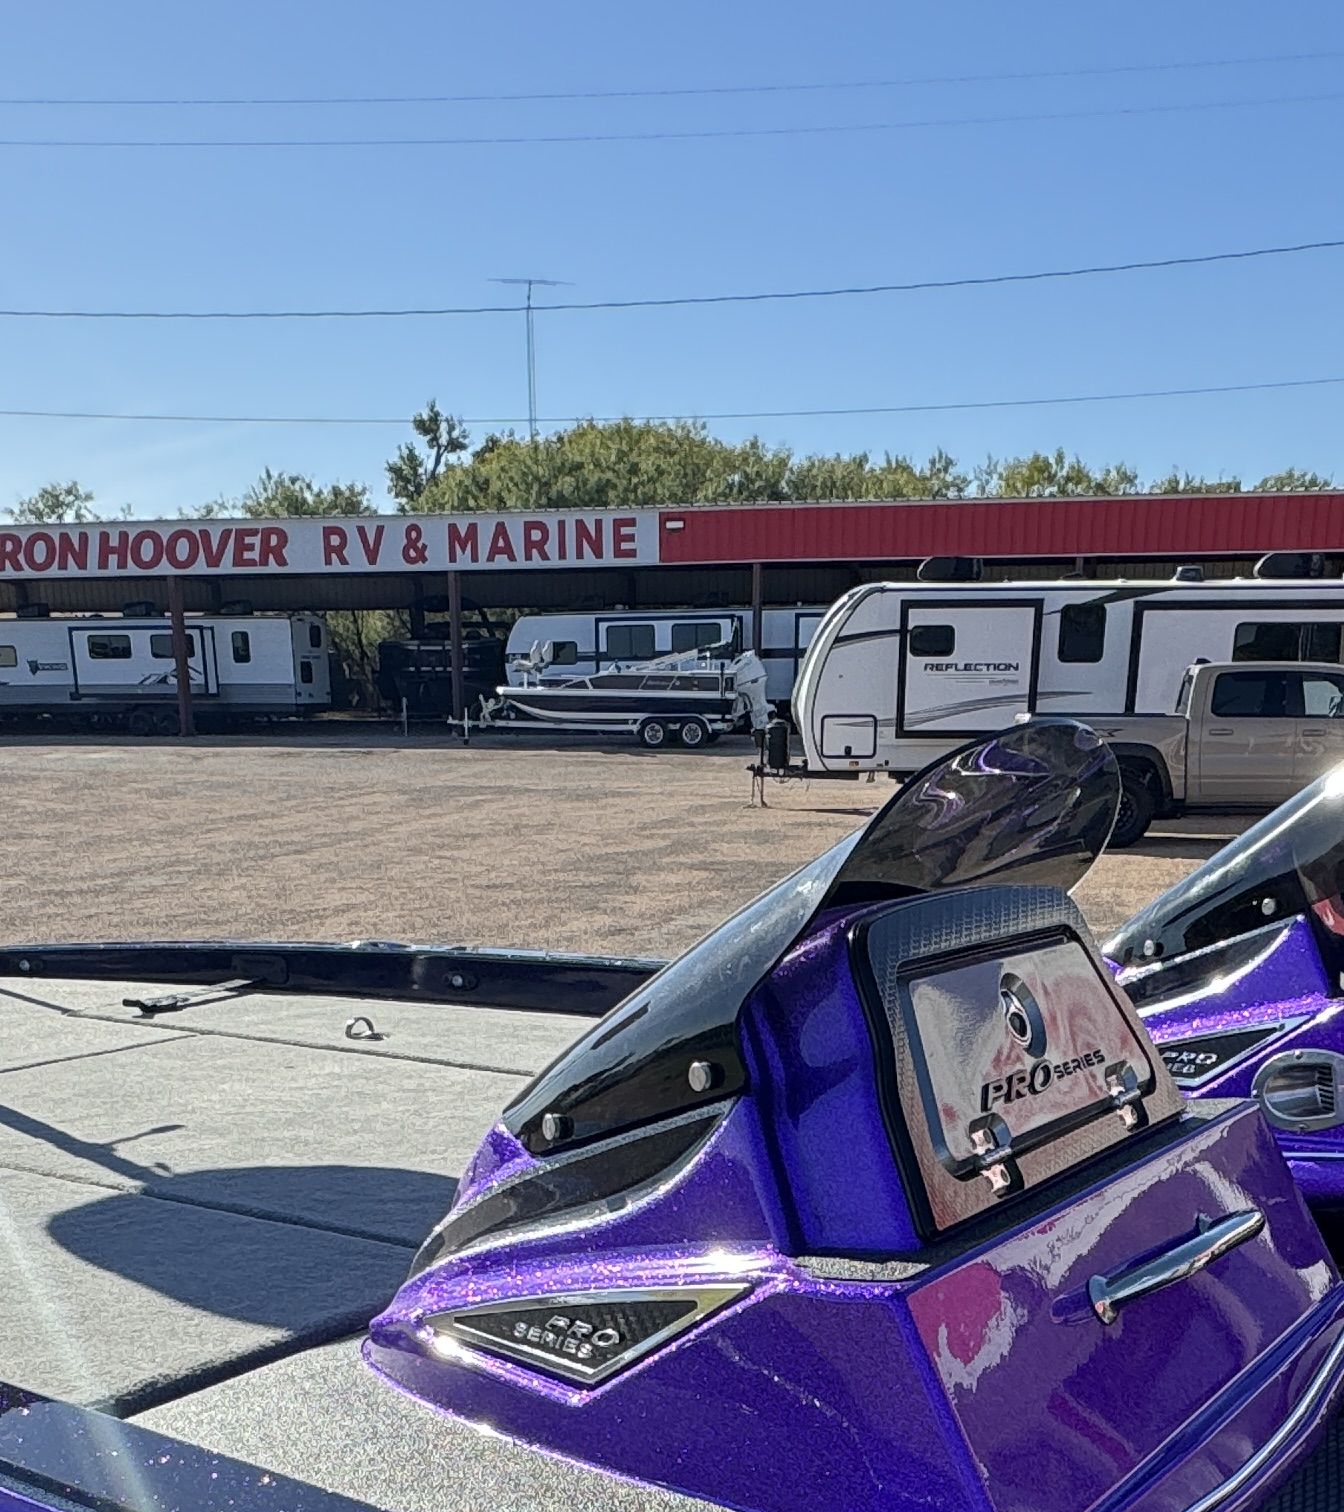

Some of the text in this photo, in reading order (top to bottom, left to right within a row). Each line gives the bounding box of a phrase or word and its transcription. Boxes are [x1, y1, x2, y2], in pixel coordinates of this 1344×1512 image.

[98, 527, 289, 570] HOOVER
[322, 525, 385, 566] RV
[402, 523, 428, 565] &
[447, 517, 638, 563] MARINE
[924, 663, 1019, 672] REFLECTION
[981, 1049, 1106, 1112] PRO SERIES
[513, 1321, 594, 1359] SERIES
[544, 1315, 621, 1348] PRO
